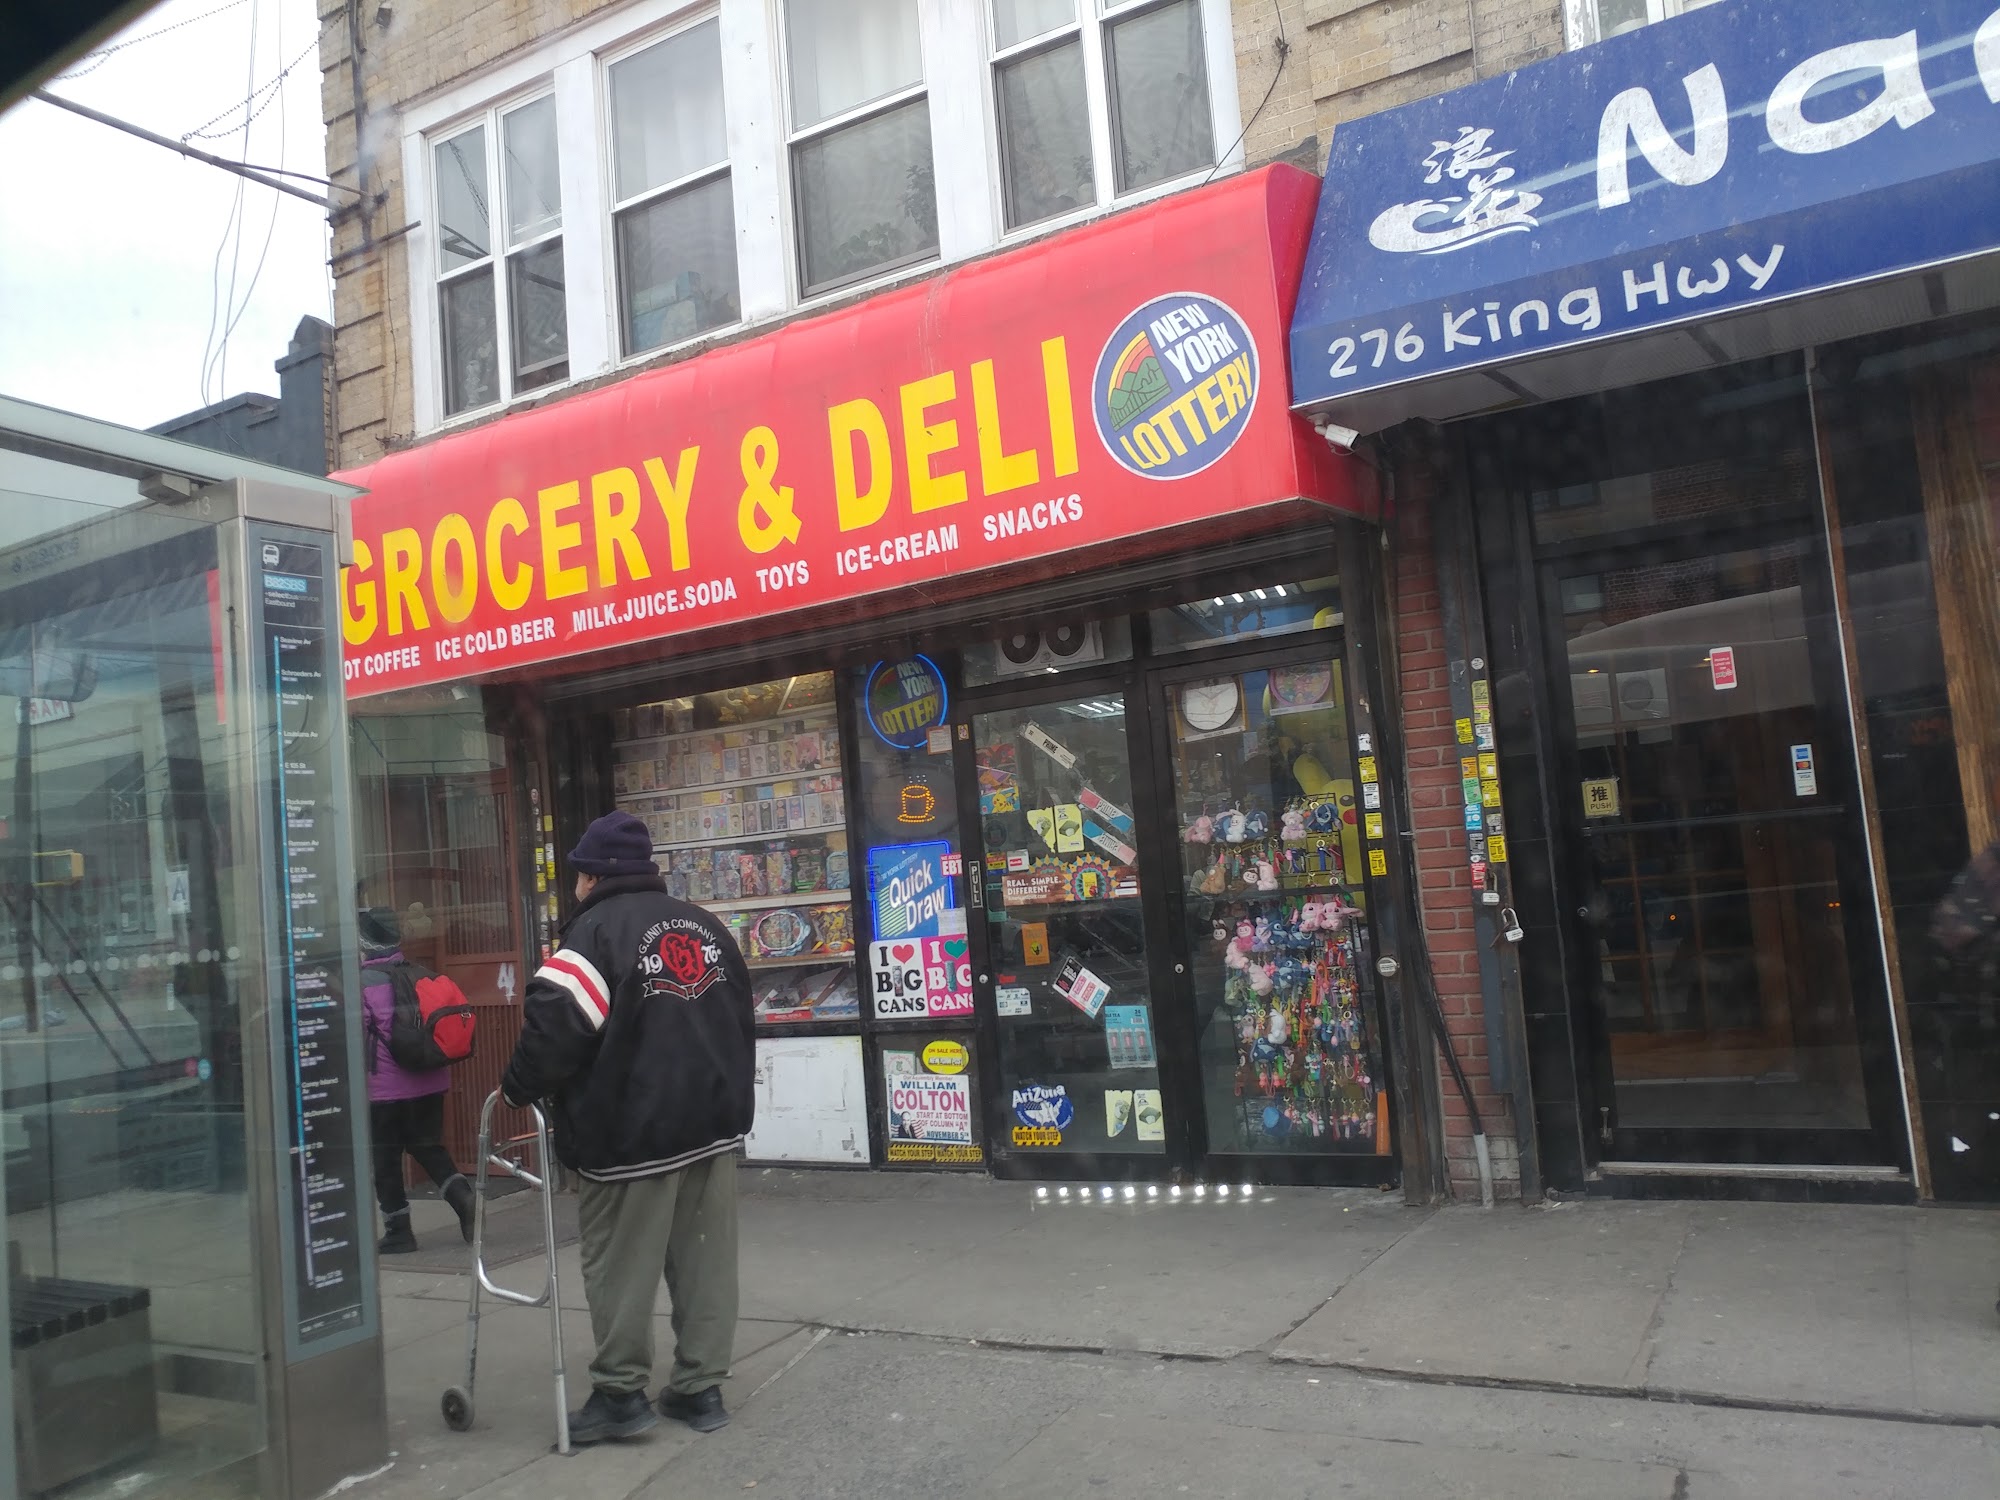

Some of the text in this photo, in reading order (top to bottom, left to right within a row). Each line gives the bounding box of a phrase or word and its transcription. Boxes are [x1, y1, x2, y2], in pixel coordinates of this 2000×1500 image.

[1598, 8, 2000, 210] Na
[1327, 243, 1786, 380] 276 King Hwy
[1150, 303, 1210, 349] NEW
[1164, 322, 1239, 384] YORK
[1119, 351, 1253, 469] LOTTERY
[340, 335, 1079, 645] GROCERY & DELI
[344, 658, 362, 681] OT
[364, 646, 421, 677] COFFEE
[435, 636, 462, 662] ICE
[464, 627, 508, 656] COLD
[510, 616, 556, 646] BEER
[755, 560, 810, 593] TOYS
[835, 523, 959, 576] ICE-CREAM
[983, 493, 1084, 542] SNACKS
[897, 660, 924, 678] NEW
[901, 674, 935, 699] YORK
[875, 693, 939, 735] LOTTERY
[1043, 739, 1058, 754] PRIME
[1591, 786, 1608, 802] 推
[1590, 802, 1611, 810] PUSH
[942, 859, 963, 876] EBT
[890, 859, 933, 909] Quick
[970, 865, 981, 904] PULL
[1007, 876, 1061, 888] REAL. SIMPLE.
[1007, 885, 1051, 895] DIFFERENT.
[906, 885, 946, 932] Draw
[638, 919, 717, 954] G.UNIT & COMPANY
[642, 944, 719, 975] 19 76
[879, 946, 889, 966] I
[929, 941, 942, 963] I
[878, 997, 925, 1013] CANS
[900, 1081, 957, 1090] WILLIAM
[893, 1089, 966, 1112] COLTON
[930, 1120, 954, 1128] COLUMN
[944, 1112, 968, 1120] BOTTOM
[926, 1130, 959, 1139] NOVEMBER
[890, 1149, 933, 1158] WATCH YOUR STEP
[955, 1150, 968, 1158] YOUR
